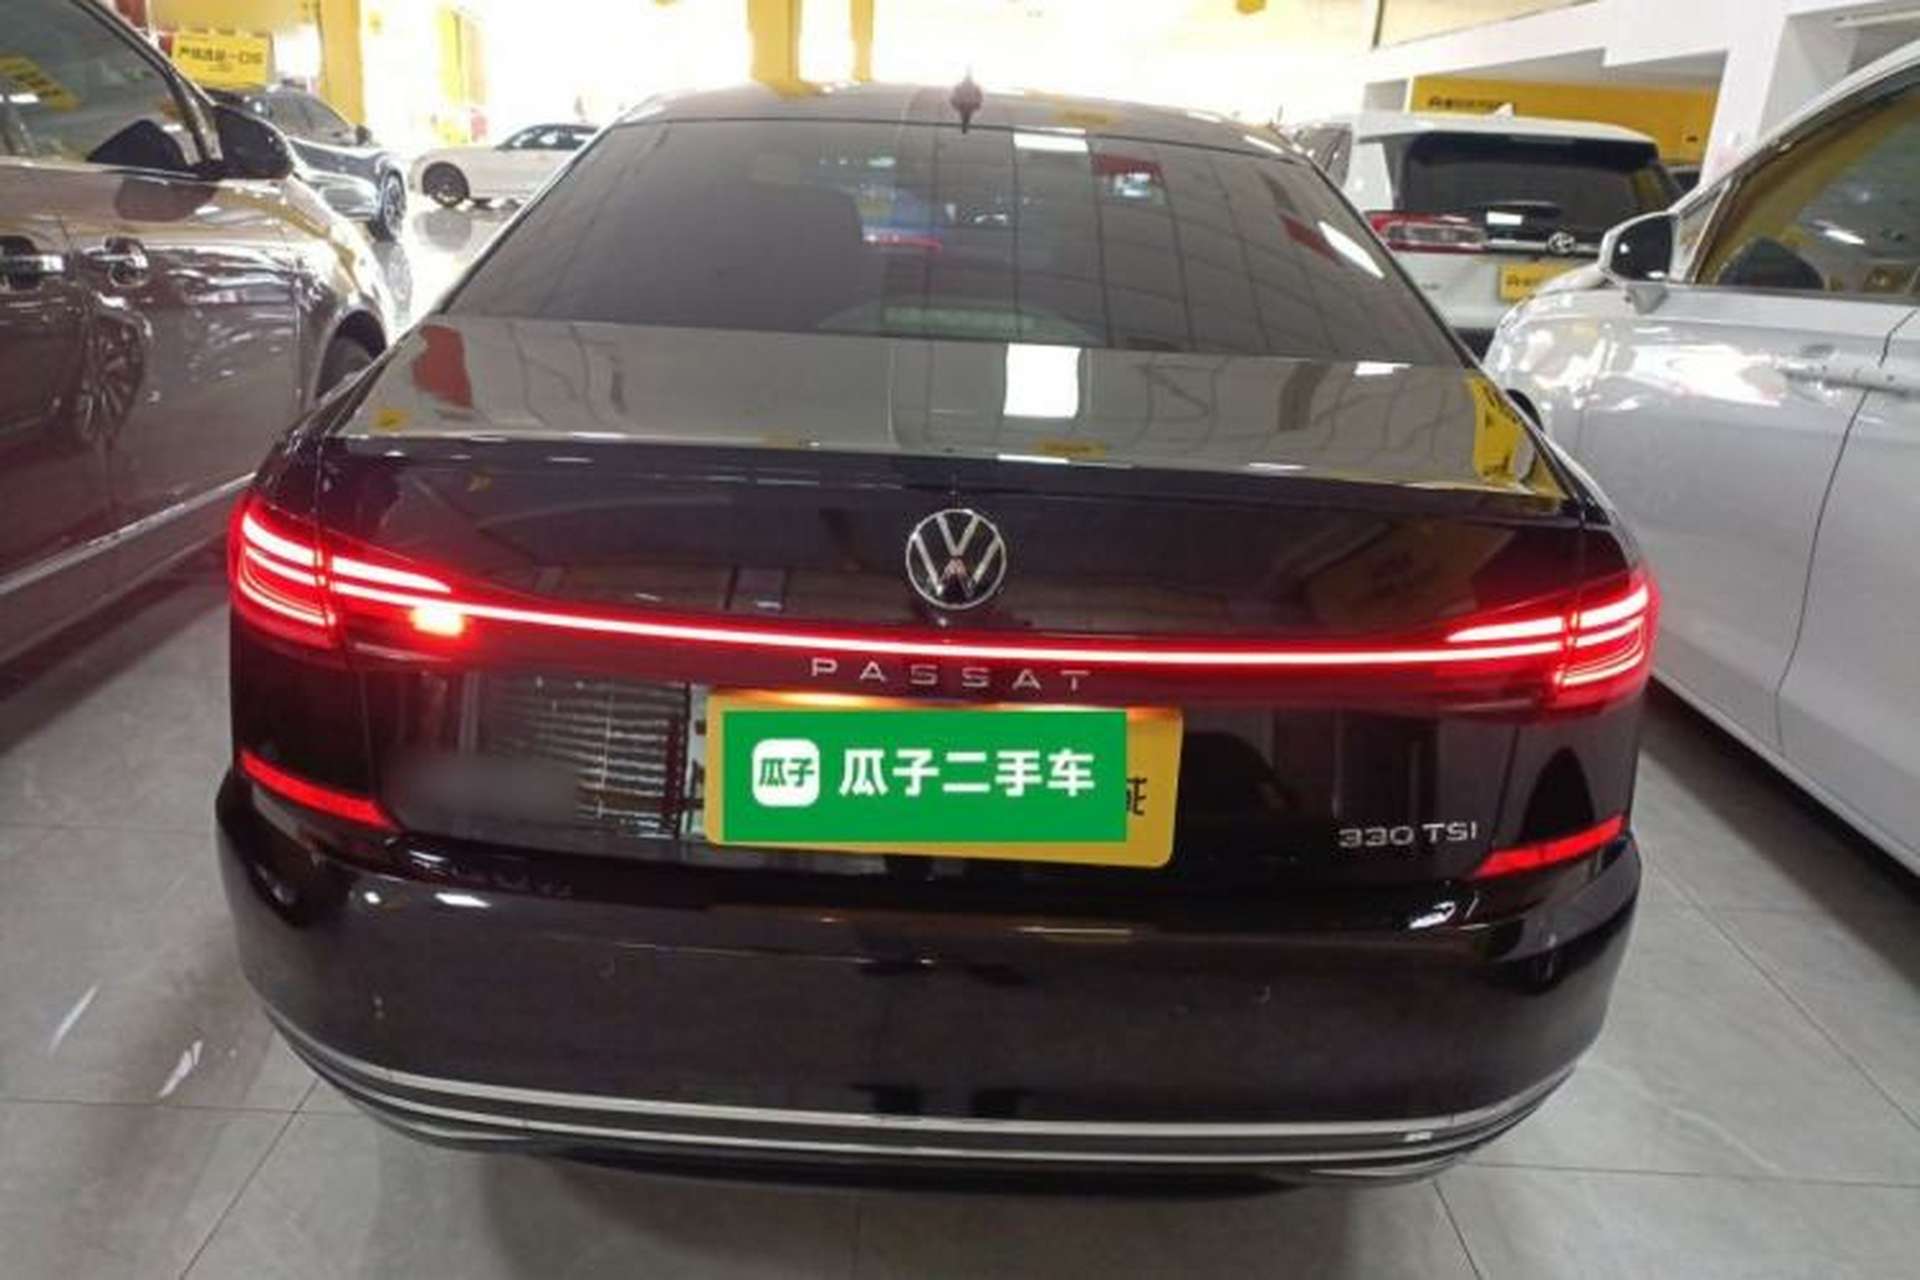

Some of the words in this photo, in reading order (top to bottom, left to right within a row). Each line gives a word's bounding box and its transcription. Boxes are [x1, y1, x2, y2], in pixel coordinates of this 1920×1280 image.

[811, 658, 1091, 692] PASSAT
[1338, 825, 1415, 848] 330
[1421, 821, 1478, 844] TSI
